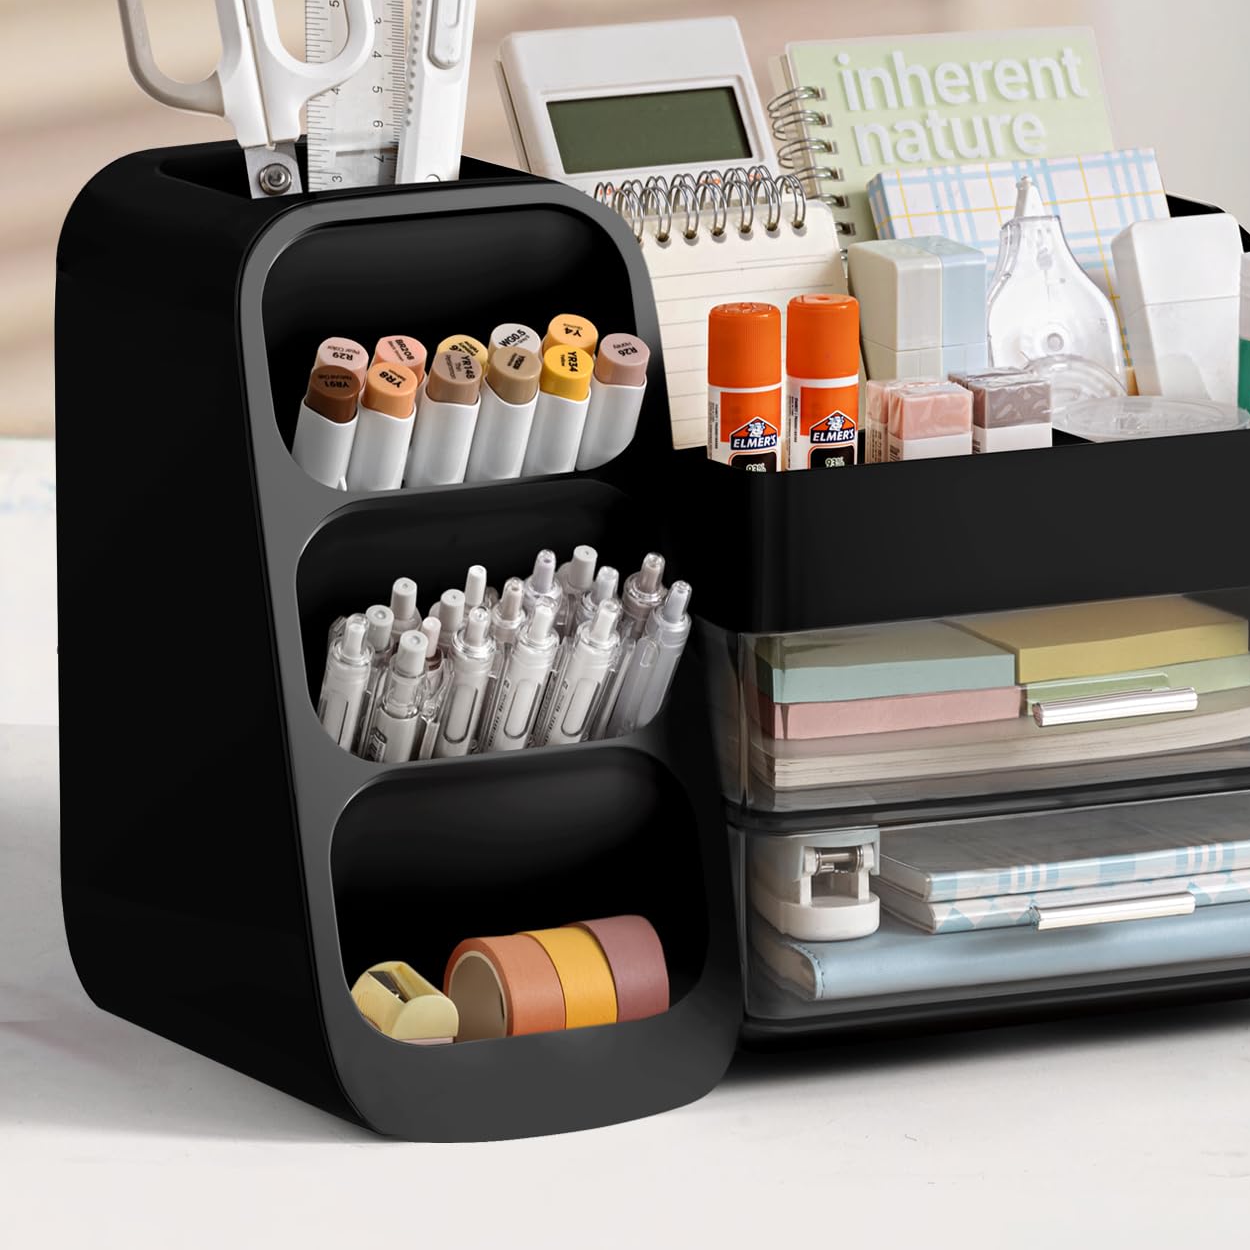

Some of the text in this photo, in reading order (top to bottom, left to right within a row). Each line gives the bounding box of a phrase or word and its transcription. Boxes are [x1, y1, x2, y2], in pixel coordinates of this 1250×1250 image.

[329, 0, 340, 8] 5
[372, 50, 382, 59] 4
[836, 46, 1089, 111] inherent
[372, 85, 383, 93] 5
[373, 120, 383, 128] 6
[851, 109, 1046, 166] nature
[373, 154, 384, 163] 7
[331, 175, 343, 183] 3
[498, 328, 527, 347] WG0.5
[564, 327, 582, 338] Y4
[332, 351, 354, 361] R29
[618, 346, 638, 357] R26
[567, 350, 579, 373] YR34
[461, 355, 476, 380] YR148
[379, 371, 402, 388] YR8
[812, 428, 855, 442] ELMER'S
[733, 434, 777, 448] ELMER'S
